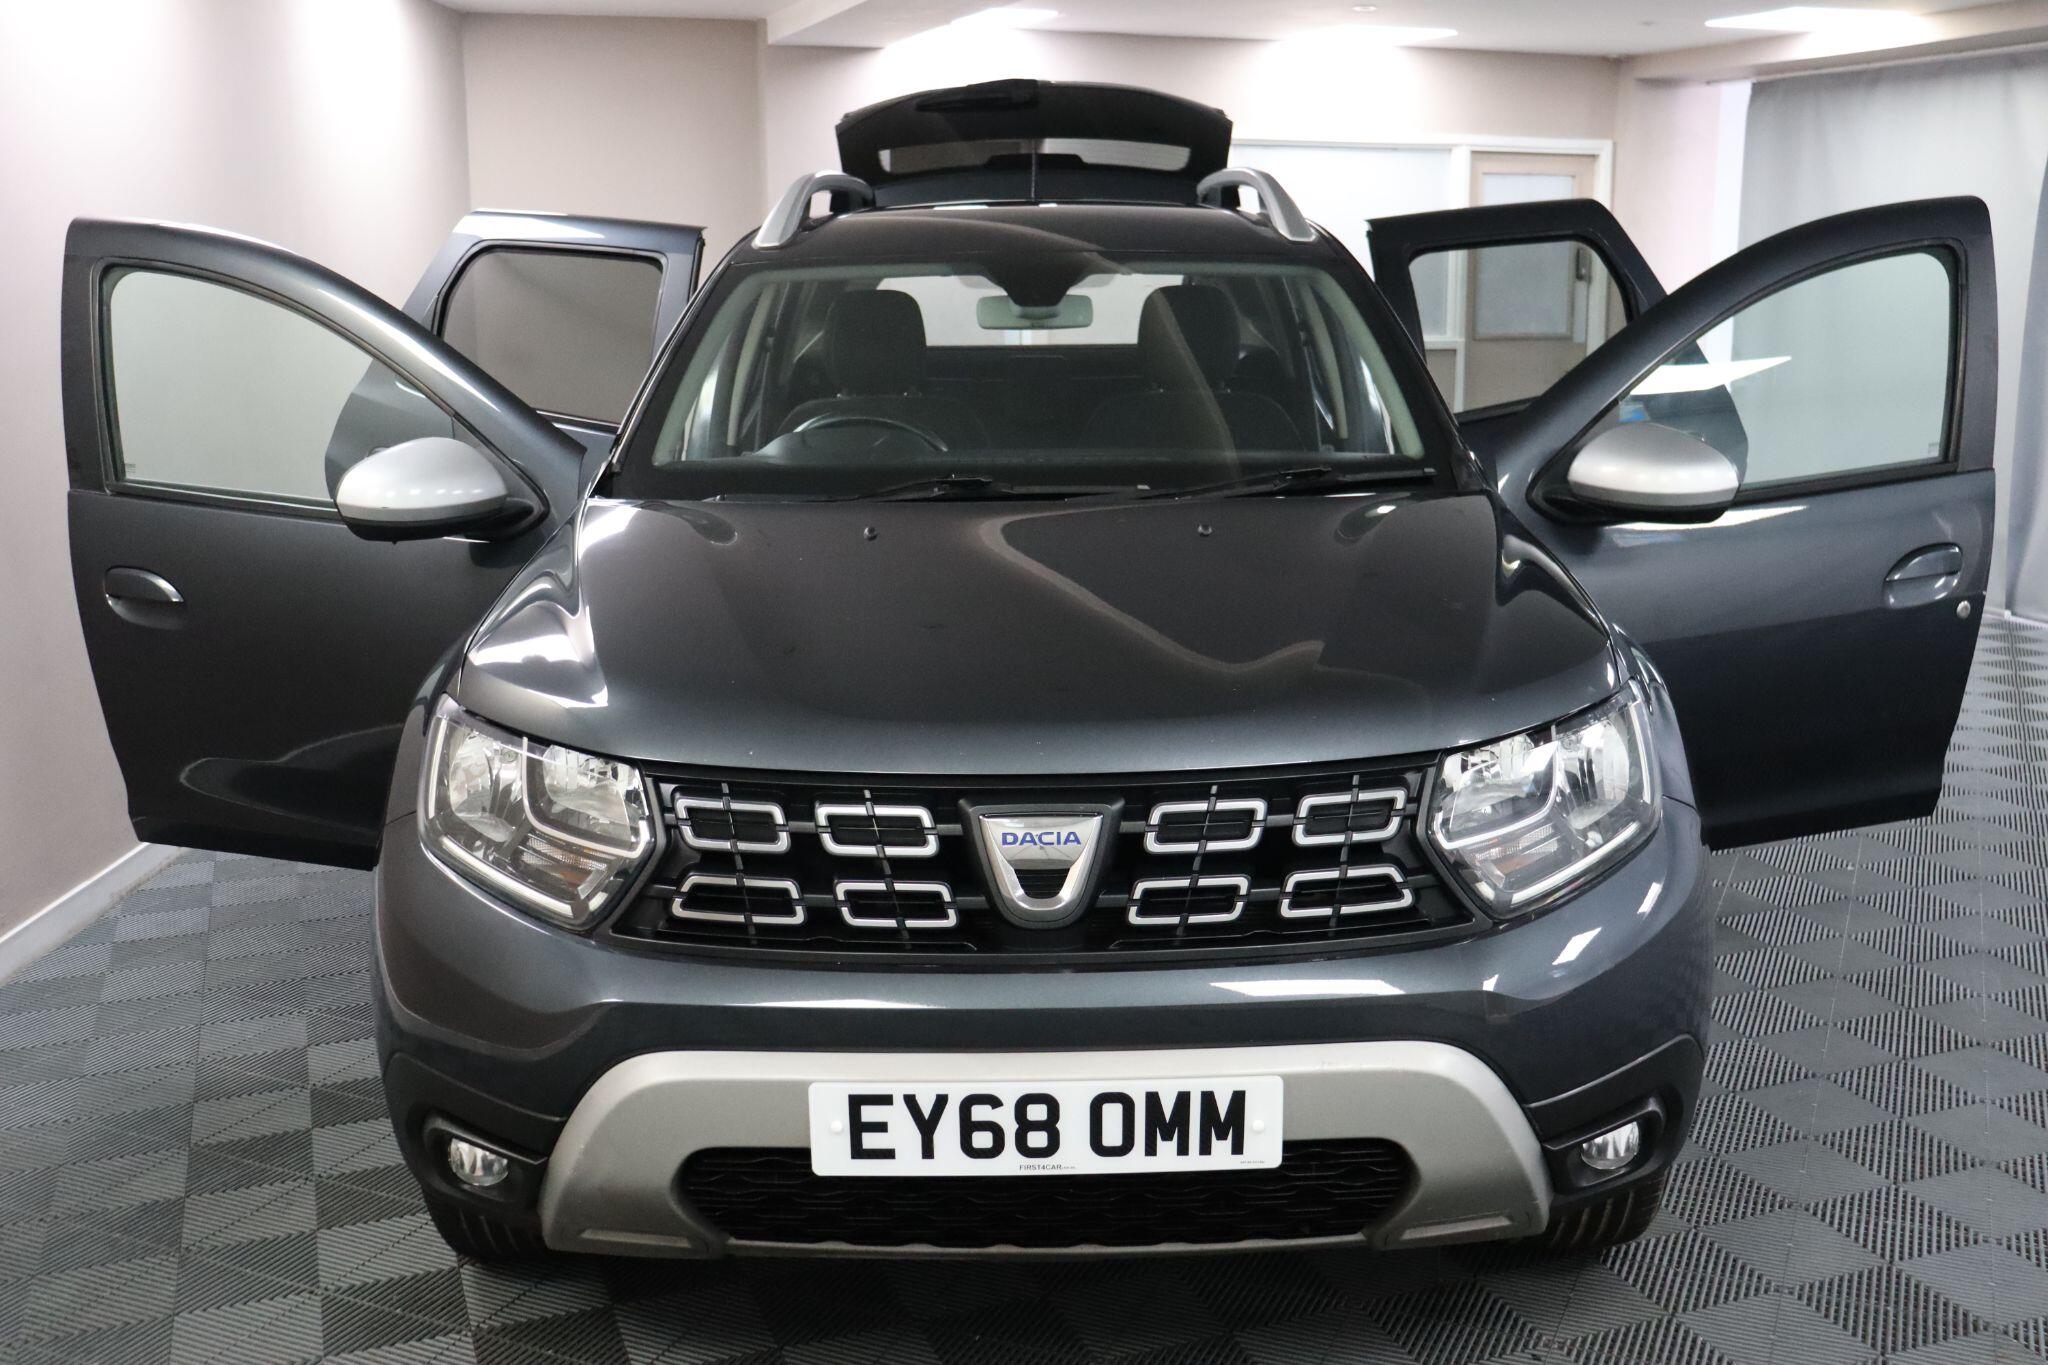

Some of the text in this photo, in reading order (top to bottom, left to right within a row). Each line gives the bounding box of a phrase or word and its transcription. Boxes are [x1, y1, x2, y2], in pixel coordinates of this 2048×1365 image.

[1001, 831, 1082, 846] DACIA
[848, 1090, 1247, 1160] EY68 OMM
